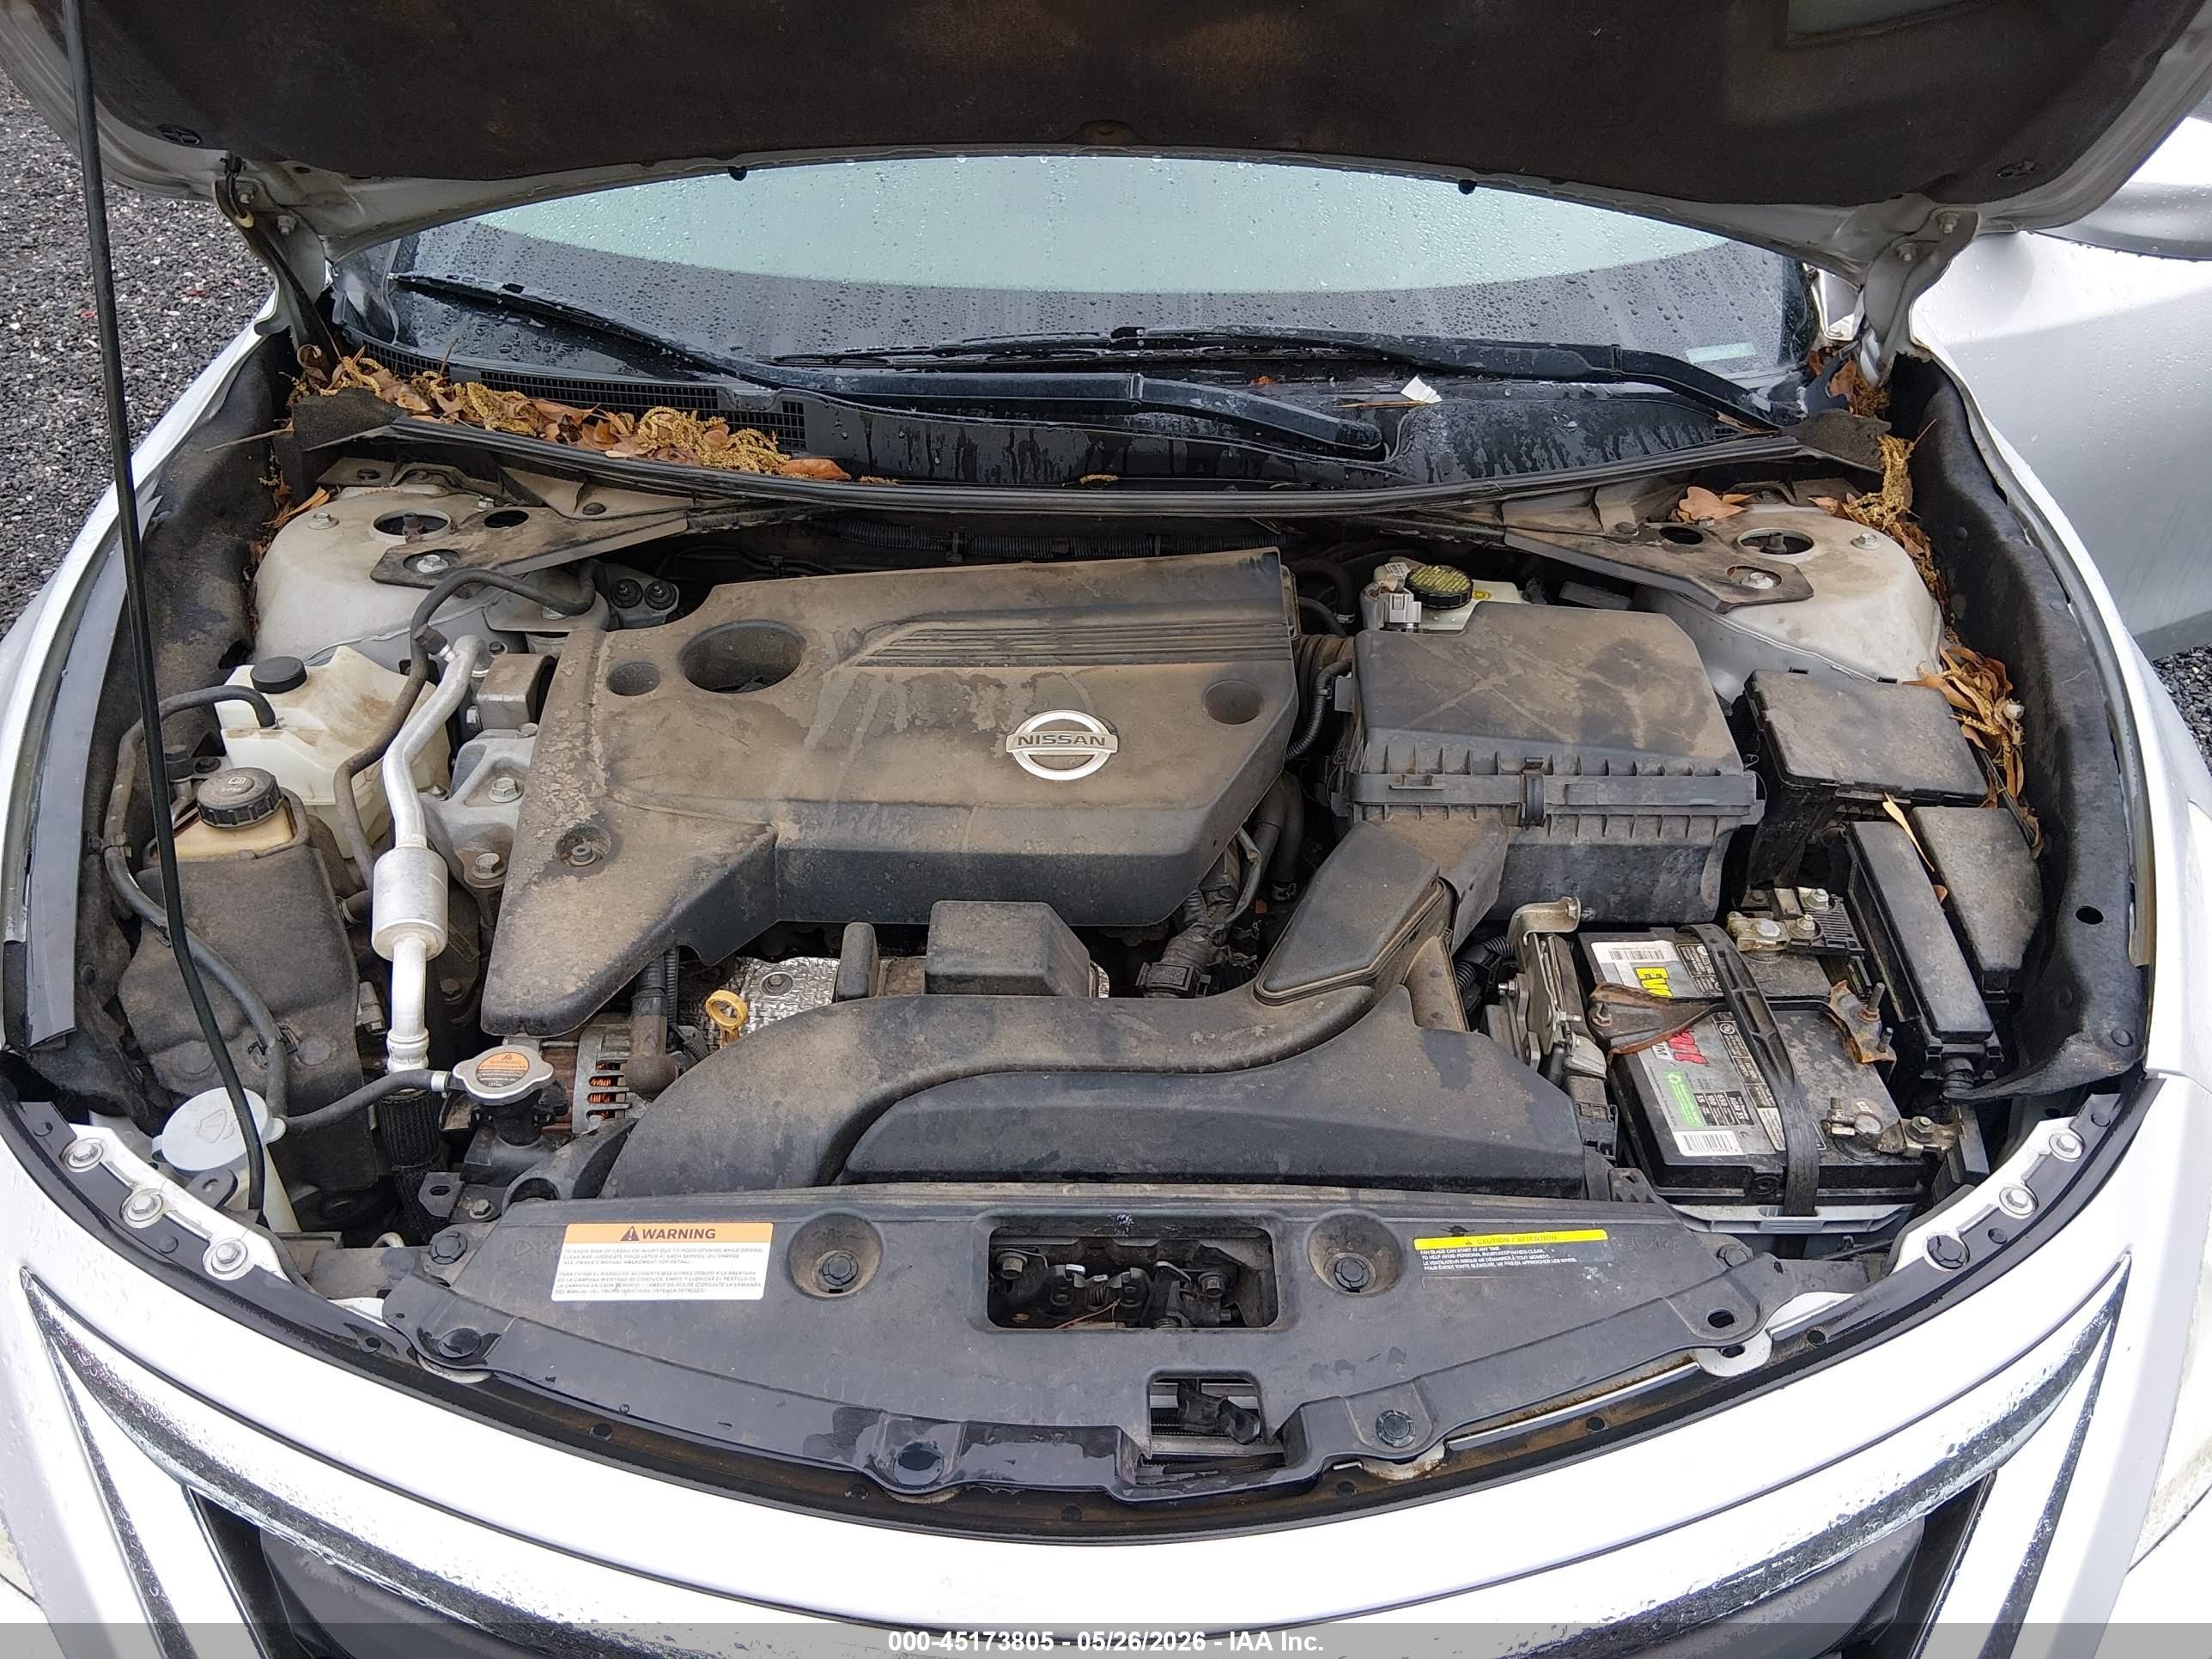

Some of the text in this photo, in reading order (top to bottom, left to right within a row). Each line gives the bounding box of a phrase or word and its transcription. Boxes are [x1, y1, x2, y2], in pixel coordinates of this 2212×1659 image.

[1018, 734, 1106, 746] NISSAN
[1707, 1095, 1717, 1106] 100
[1717, 1094, 1728, 1107] 650
[1729, 1097, 1741, 1111] AGM
[1736, 1112, 1745, 1120] 35
[642, 1228, 716, 1240] WARNING
